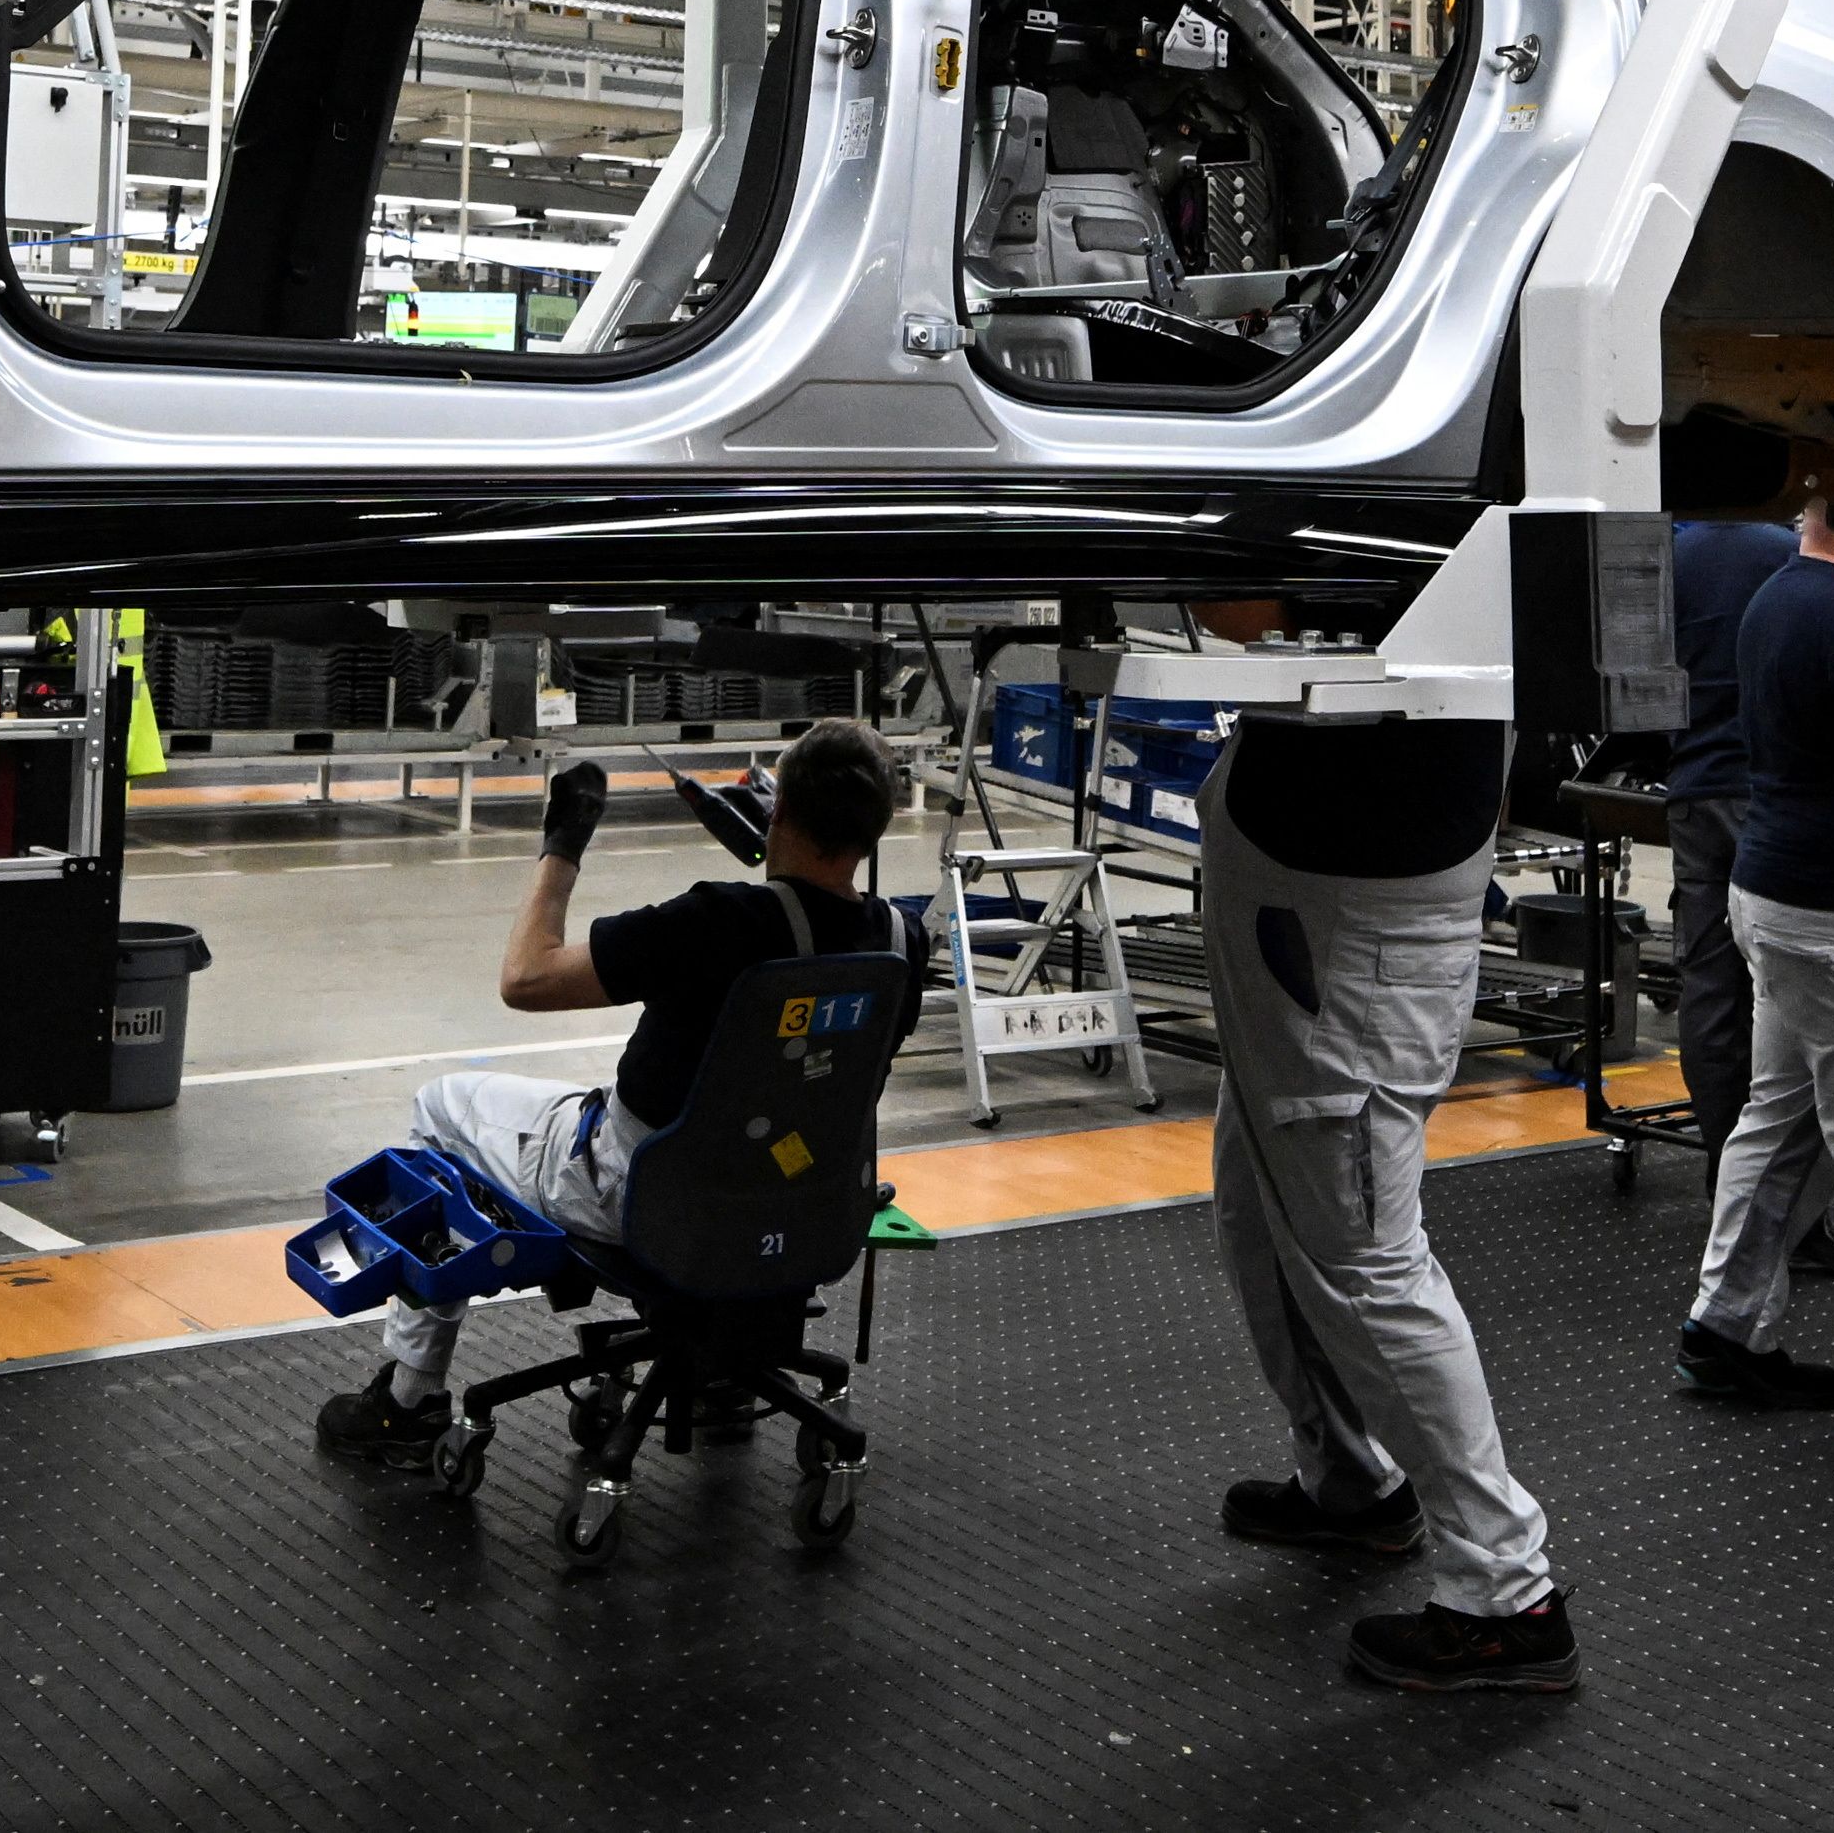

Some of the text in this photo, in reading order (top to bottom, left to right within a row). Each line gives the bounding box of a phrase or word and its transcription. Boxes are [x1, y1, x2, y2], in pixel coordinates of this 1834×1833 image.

[135, 255, 159, 268] 2700
[162, 258, 174, 272] kg
[760, 1232, 785, 1256] 21
